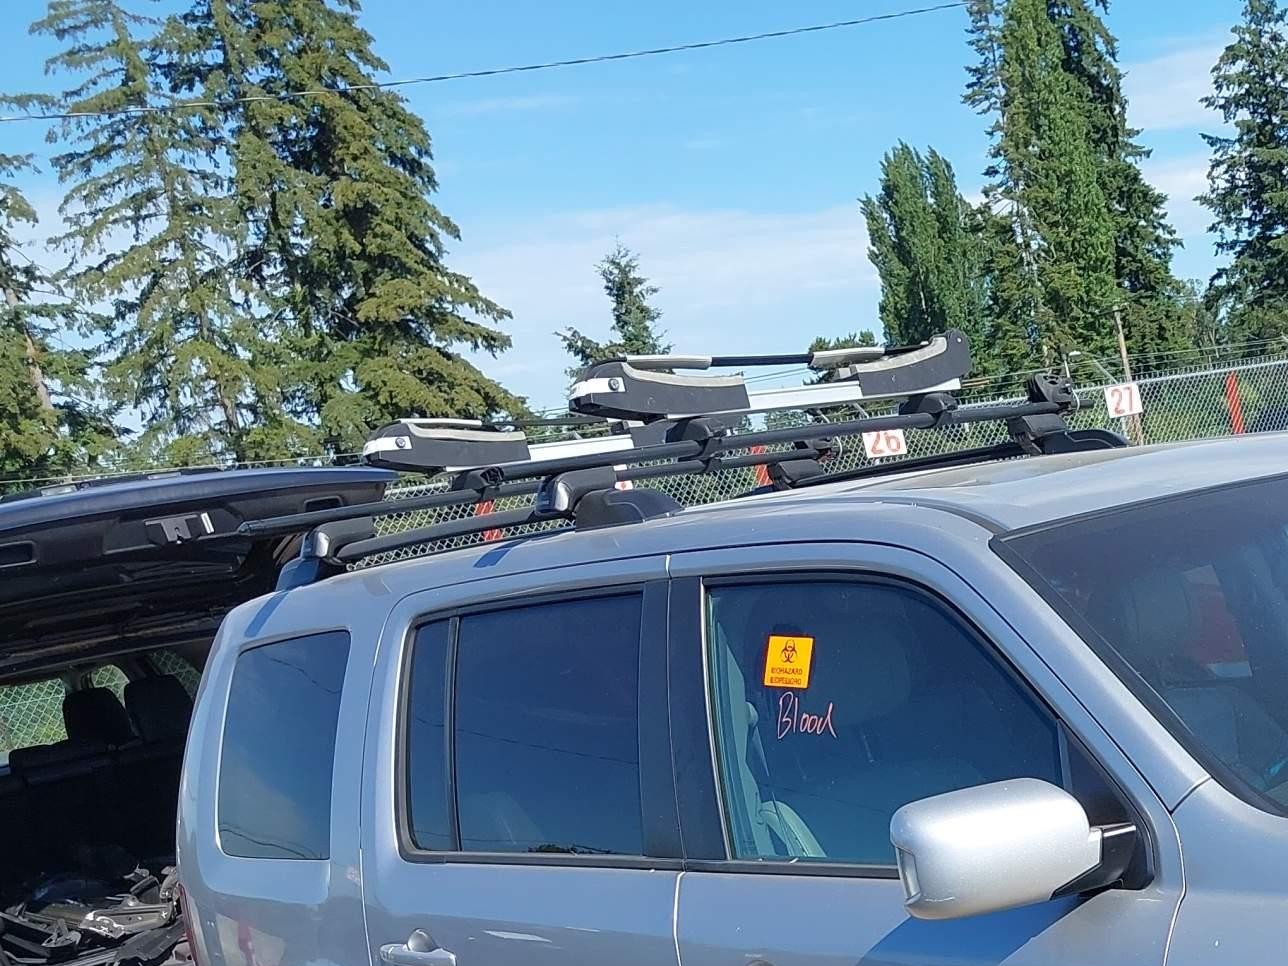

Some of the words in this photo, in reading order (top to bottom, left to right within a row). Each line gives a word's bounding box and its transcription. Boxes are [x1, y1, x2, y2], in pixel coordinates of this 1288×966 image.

[1110, 386, 1134, 415] 27
[870, 431, 901, 455] 26
[777, 691, 837, 739] Blood
